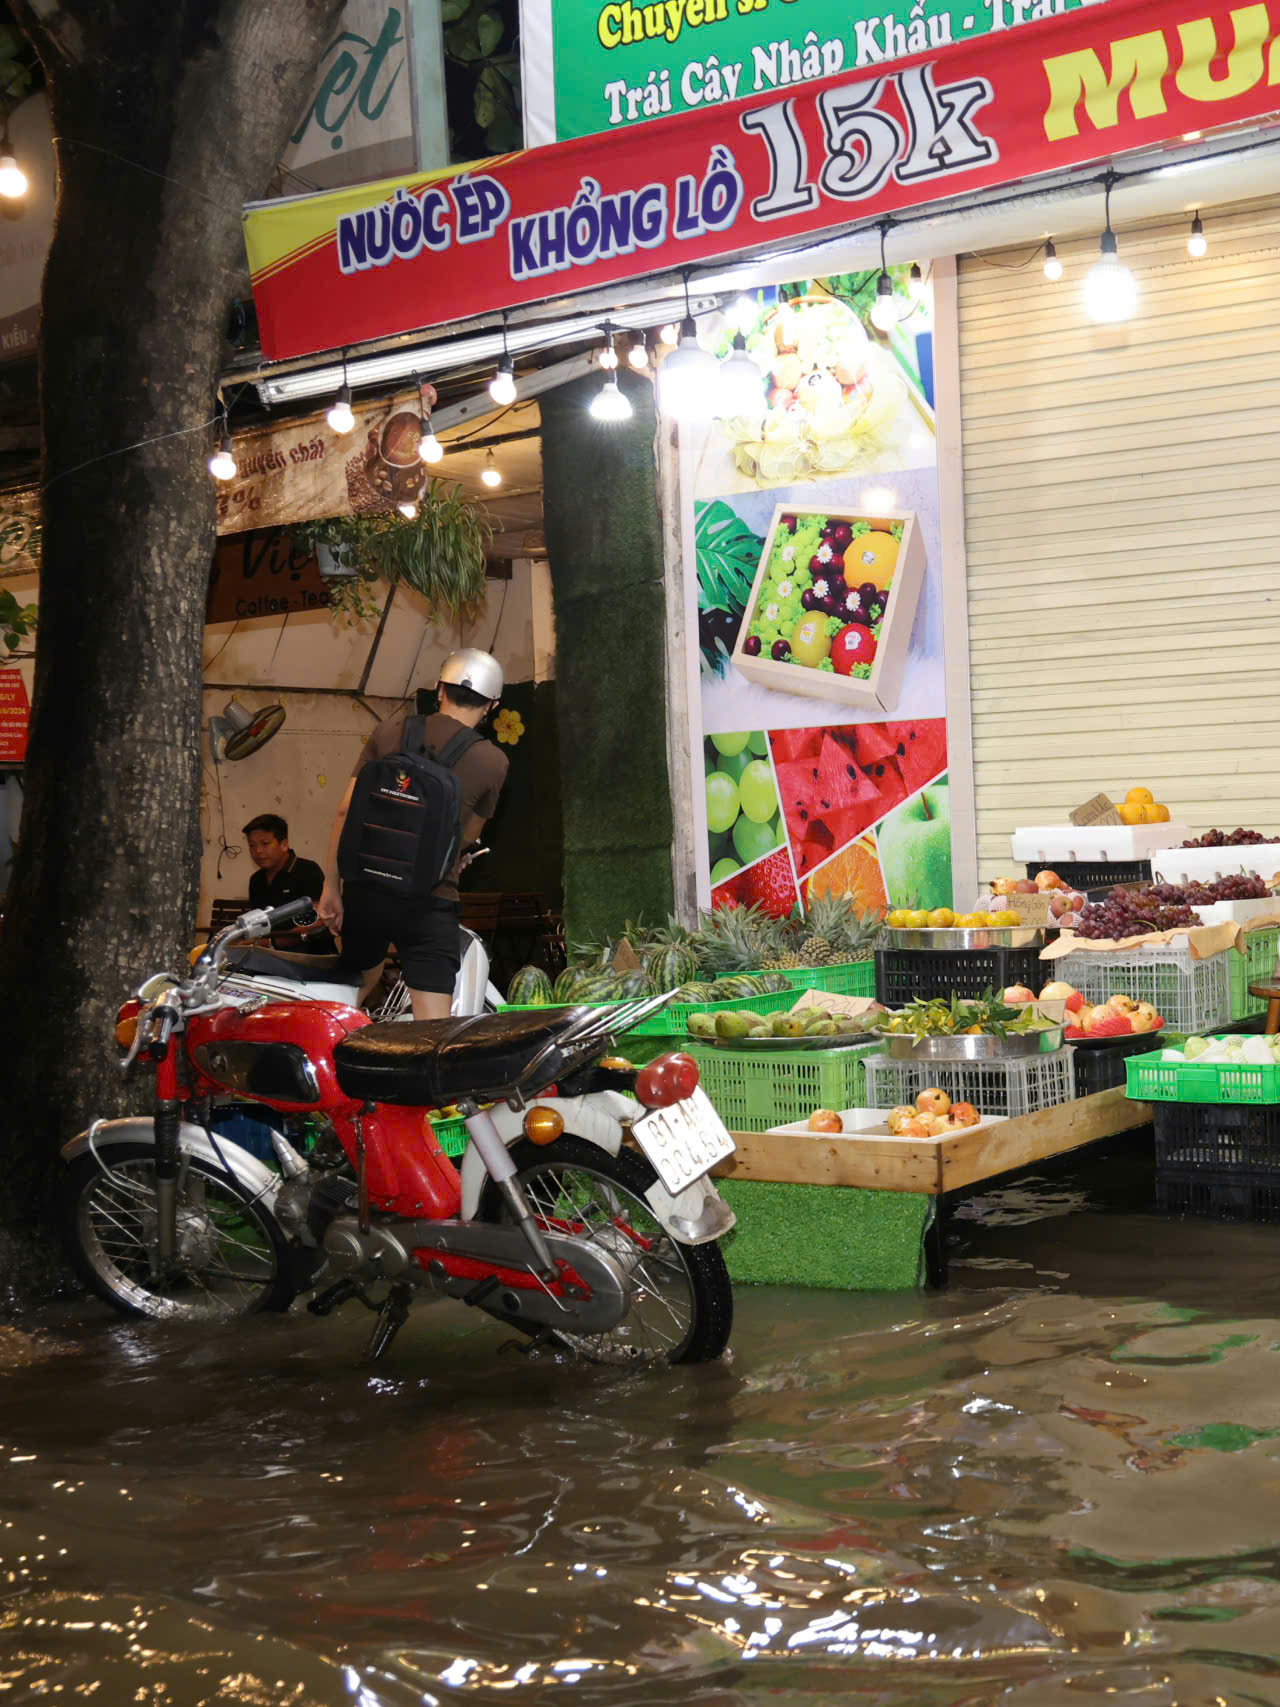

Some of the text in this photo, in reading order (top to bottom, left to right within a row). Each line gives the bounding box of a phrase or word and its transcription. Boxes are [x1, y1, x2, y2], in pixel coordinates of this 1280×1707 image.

[604, 69, 672, 124] Trái
[681, 54, 743, 106] Cây
[340, 189, 448, 268] NƯỚC
[454, 174, 506, 240] ÉP
[511, 180, 662, 275] KHỔNG
[676, 147, 739, 235] LỒ
[742, 64, 996, 217] 15k
